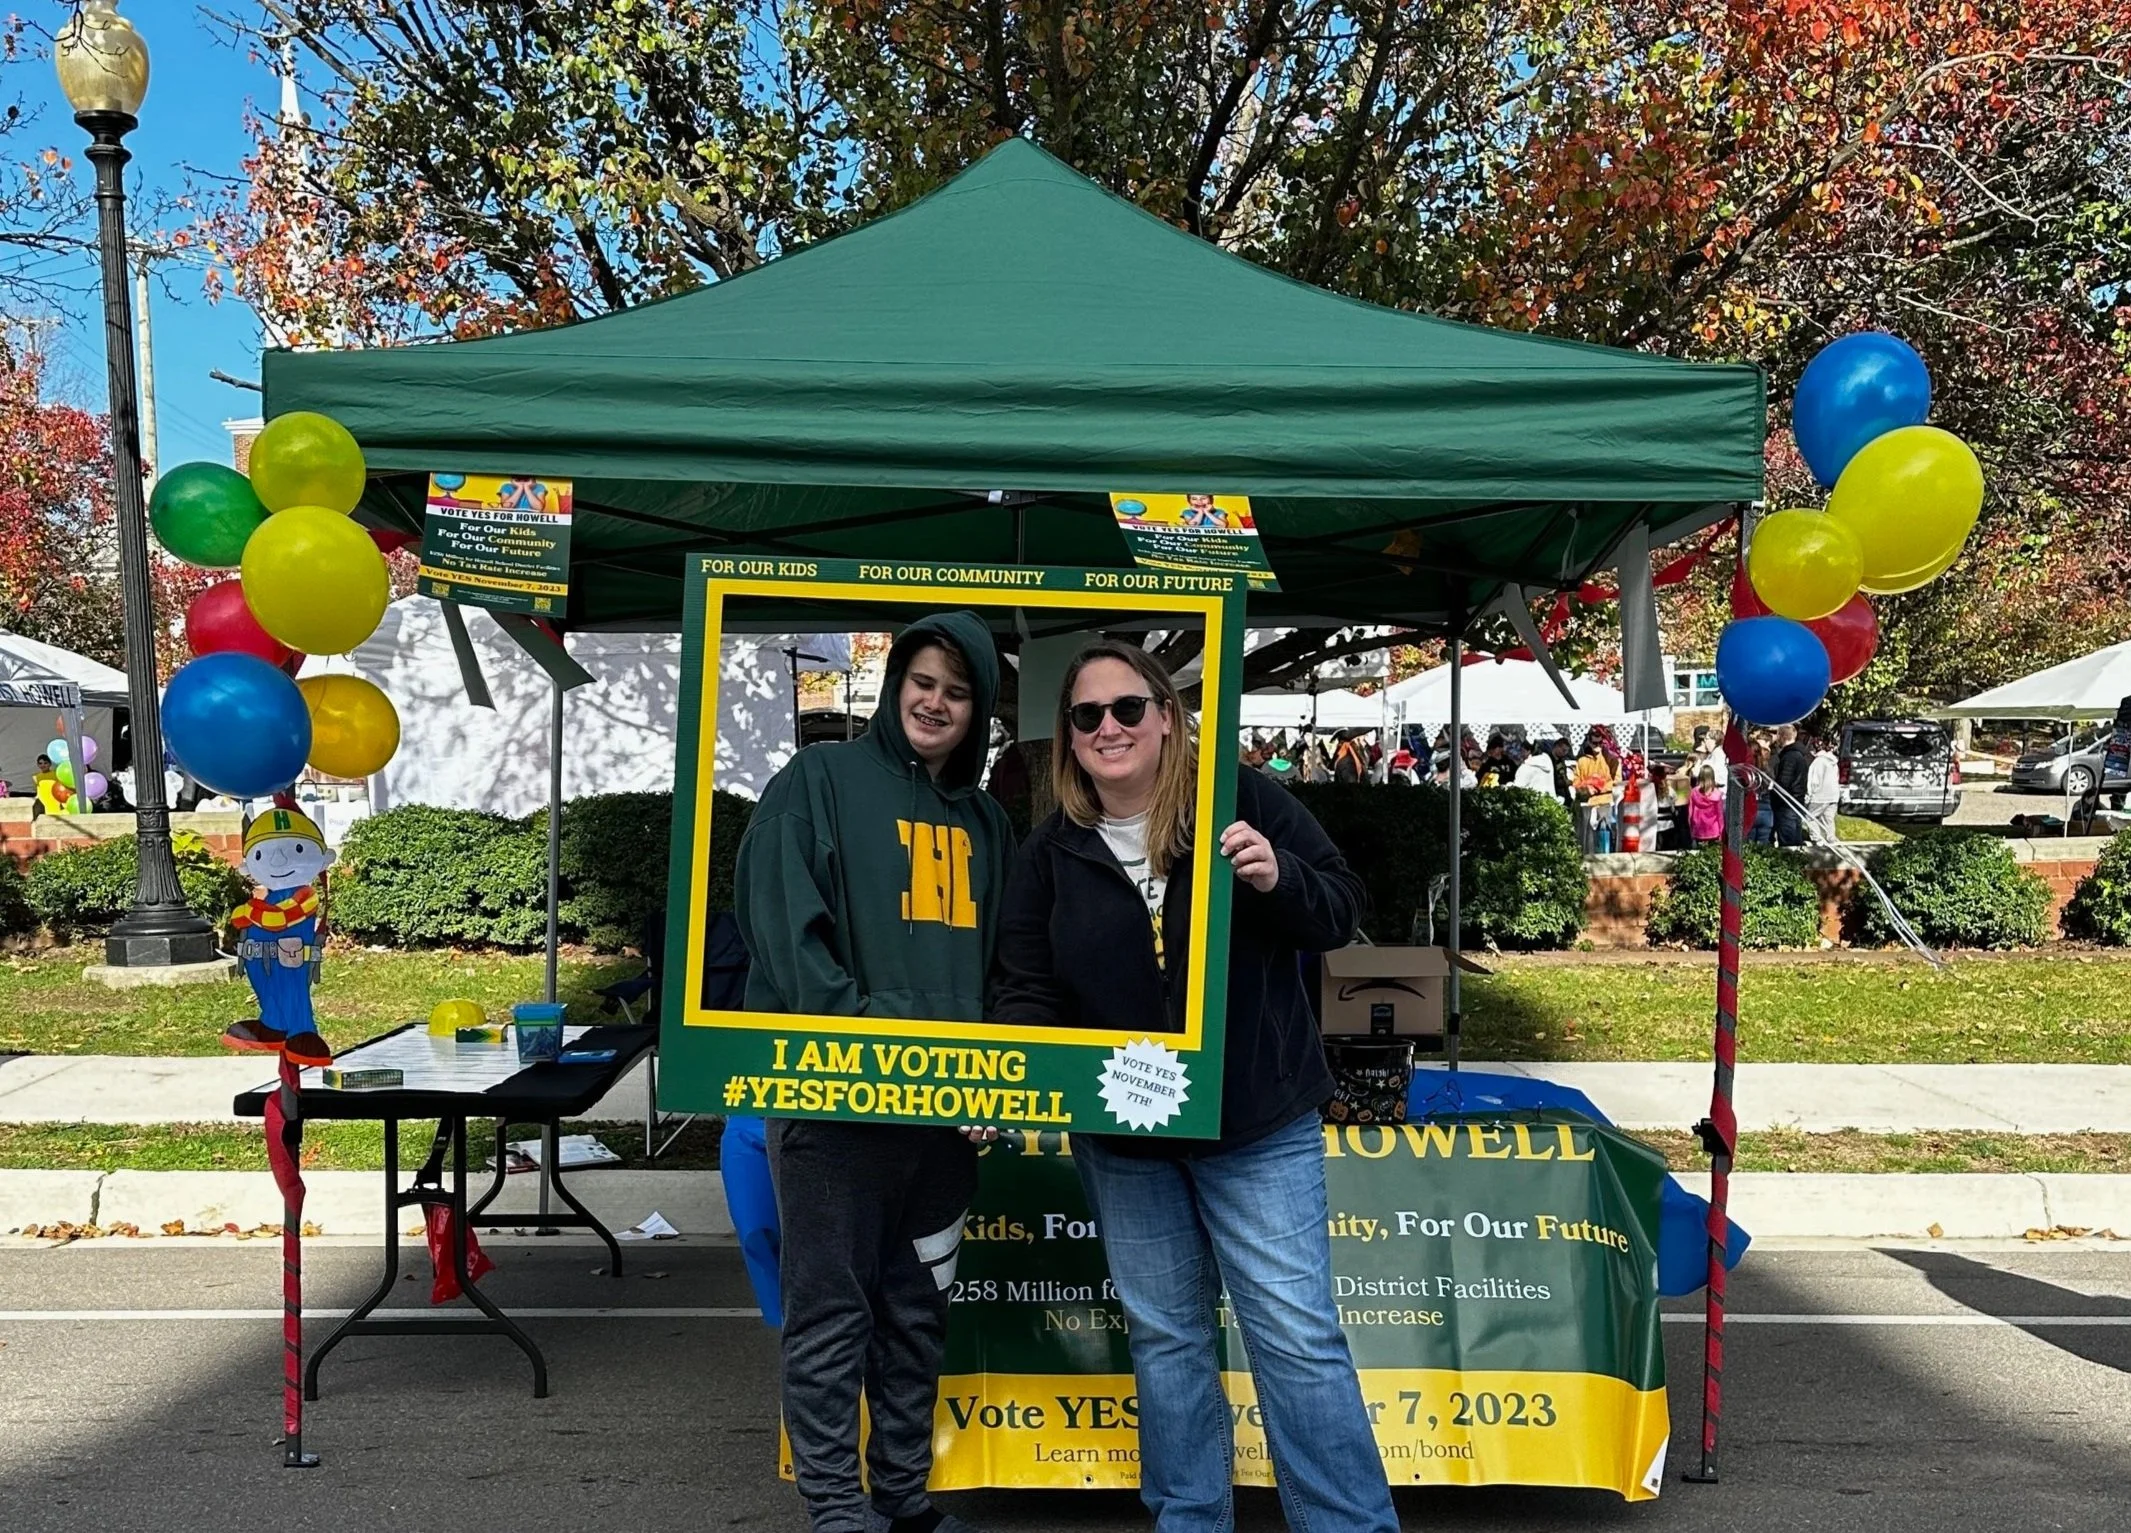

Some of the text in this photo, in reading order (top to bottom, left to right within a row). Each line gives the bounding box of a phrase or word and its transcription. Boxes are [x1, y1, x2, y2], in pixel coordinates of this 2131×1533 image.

[440, 507, 559, 523] VOTE YES FOR HOWELL
[437, 528, 557, 549] For Our Community
[459, 522, 537, 537] For Our Kids
[451, 540, 542, 558] For Our Future
[1136, 536, 1159, 544] For
[1184, 542, 1250, 552] Community
[1175, 546, 1198, 554] Our
[1200, 549, 1239, 557] Future
[442, 558, 548, 577] No Tax Rate Increase
[701, 559, 818, 577] FOR OUR KIDS
[859, 565, 1045, 585] FOR OUR COMMUNITY
[426, 568, 450, 579] Vote
[451, 572, 472, 583] YES
[473, 576, 524, 589] November
[537, 584, 561, 593] 2023
[1084, 572, 1234, 592] FOR OUR FUTURE
[17, 683, 76, 709] HOWELL
[273, 811, 292, 831] H
[772, 1038, 1027, 1082] I AM VOTING
[1122, 1055, 1177, 1081] VOTE YES
[1111, 1069, 1177, 1099] NOVEMBER
[722, 1075, 1072, 1124] #YESFORHOWELL
[1126, 1091, 1153, 1107] 7TH!
[1395, 1211, 1455, 1239] For
[1463, 1211, 1529, 1240] Our
[1535, 1214, 1630, 1253] Future
[1005, 1280, 1094, 1302] Million
[1334, 1275, 1430, 1298] District
[1435, 1276, 1551, 1300] Facilities
[1044, 1309, 1081, 1331] No
[1336, 1304, 1445, 1326] Increase
[945, 1395, 1045, 1430] Vote
[1055, 1395, 1139, 1430] YES
[1399, 1391, 1439, 1431] 7,
[1449, 1391, 1557, 1428] 2023
[1034, 1443, 1100, 1463] Learn
